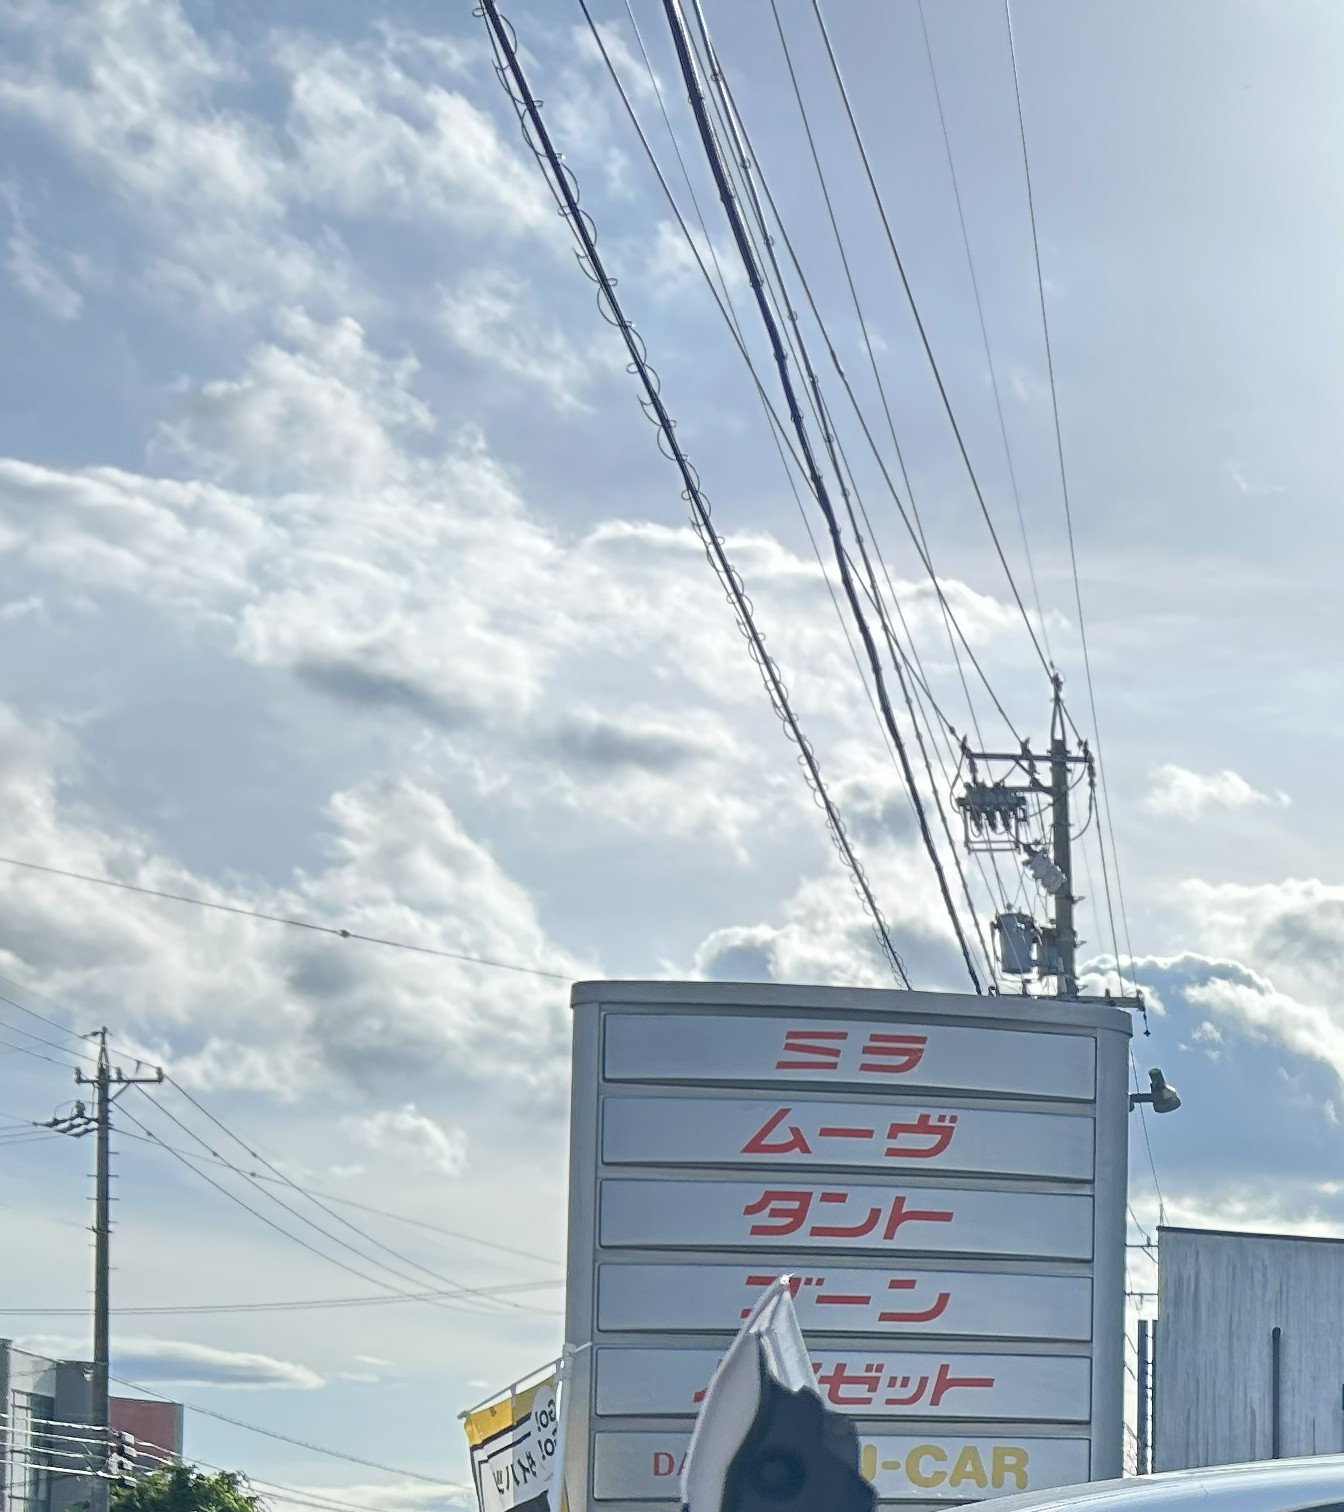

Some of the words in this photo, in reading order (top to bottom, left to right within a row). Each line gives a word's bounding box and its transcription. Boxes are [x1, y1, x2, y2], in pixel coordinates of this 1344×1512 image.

[775, 1030, 928, 1074] ミラ
[740, 1107, 958, 1159] ムーヴ
[742, 1189, 954, 1240] タント
